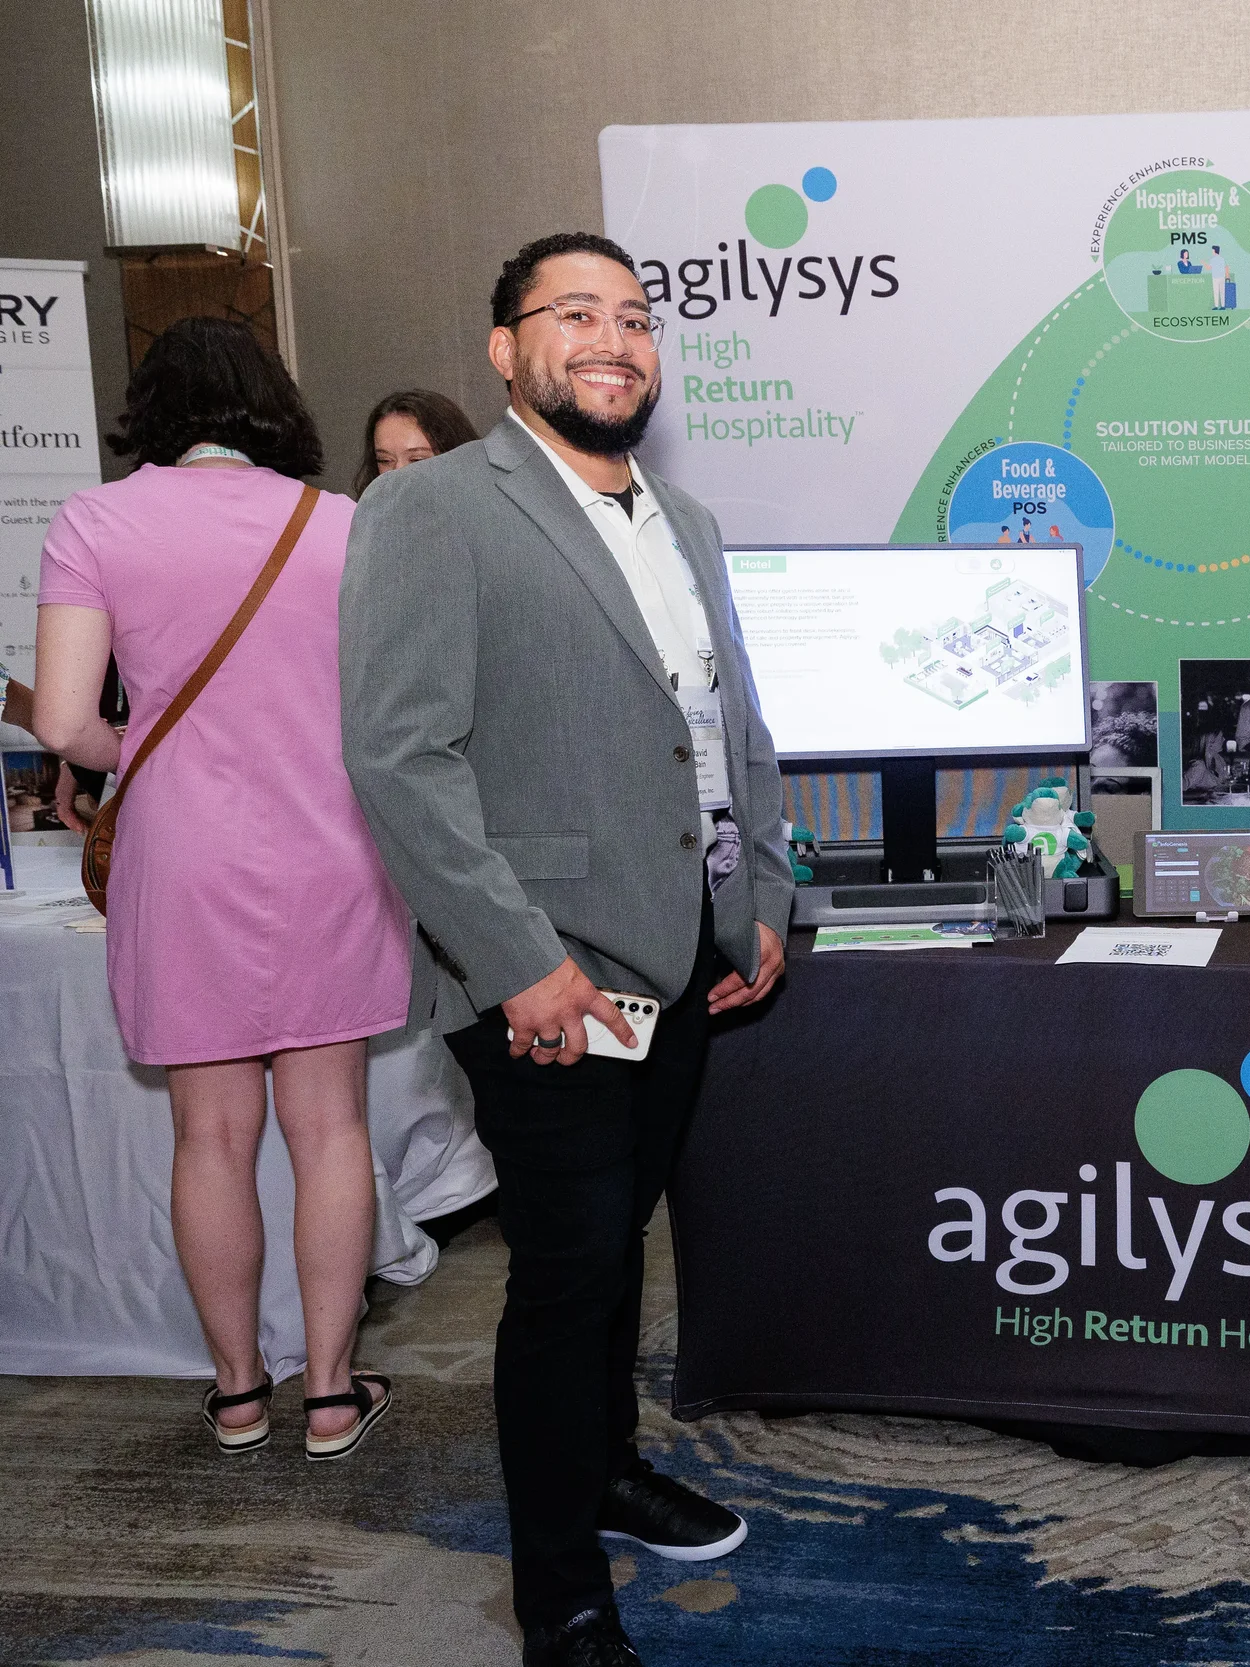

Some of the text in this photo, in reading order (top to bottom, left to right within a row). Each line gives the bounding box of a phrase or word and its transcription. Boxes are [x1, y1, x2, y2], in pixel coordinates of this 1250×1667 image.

[1090, 157, 1205, 254] EXPERIENCE ENHANCERS
[1136, 186, 1240, 211] Hospitality &
[1159, 211, 1218, 230] Leisure
[1170, 232, 1208, 245] PMS
[640, 239, 899, 319] agilysys
[1153, 316, 1230, 327] ECOSYSTEM
[680, 331, 751, 369] High
[683, 375, 794, 403] Return
[1096, 420, 1198, 437] SOLUTION
[1101, 440, 1163, 452] TAILORED
[1167, 440, 1184, 451] TO
[942, 438, 996, 496] ENHANCERS
[1001, 458, 1056, 478] Food &
[1138, 454, 1250, 466] OR MGMT MODEL
[992, 480, 1066, 502] Beverage
[1013, 502, 1047, 514] POS
[1, 515, 33, 525] Guest
[740, 559, 772, 569] Hotel
[995, 1306, 1073, 1346] High
[1084, 1310, 1209, 1347] Return
